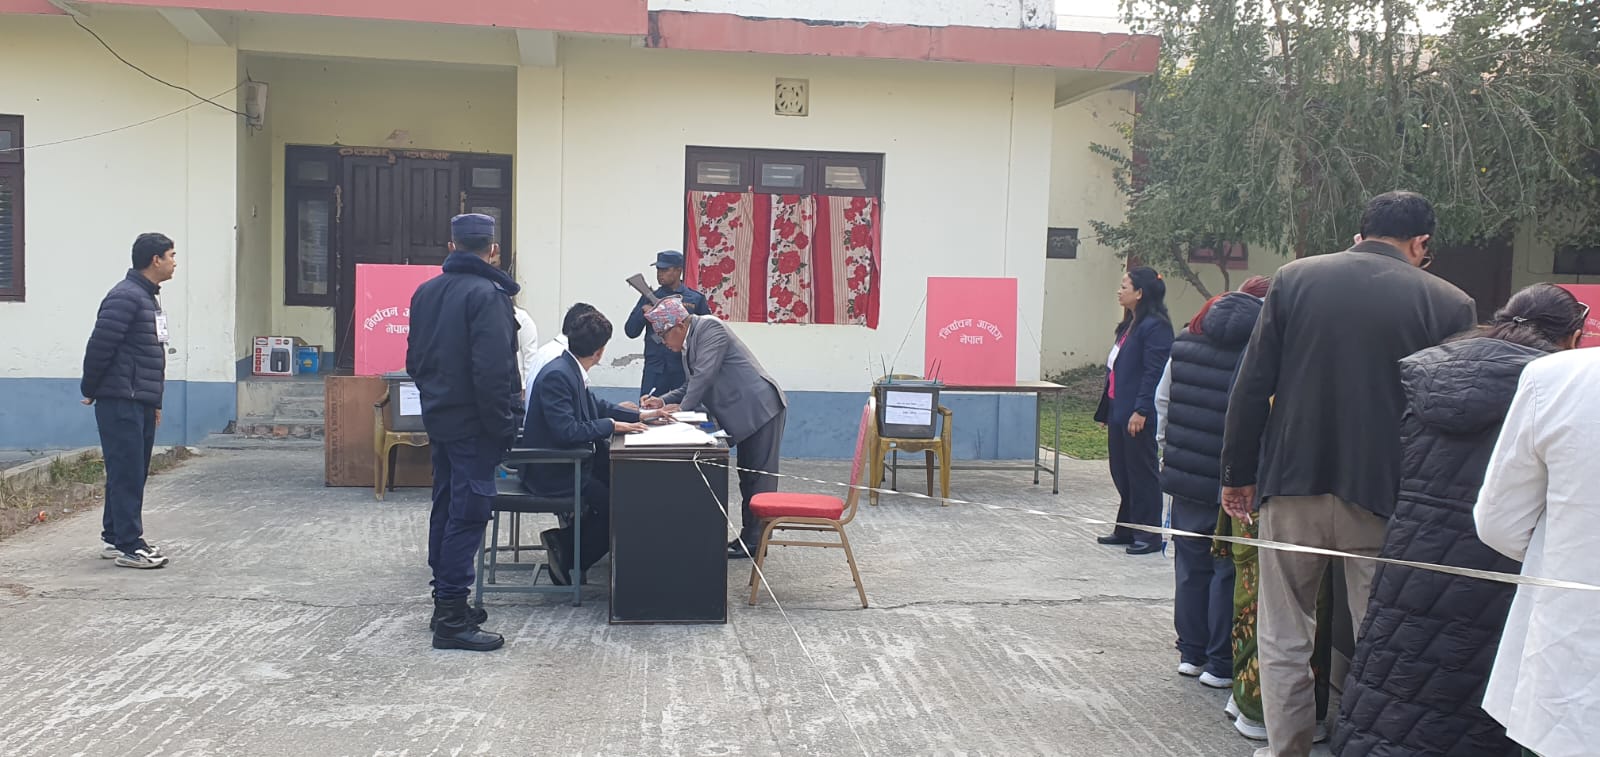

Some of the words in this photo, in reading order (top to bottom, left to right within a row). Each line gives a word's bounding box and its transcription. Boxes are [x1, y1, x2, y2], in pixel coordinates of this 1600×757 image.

[364, 306, 398, 331] निर्वाचन
[385, 323, 410, 334] नेपाल
[939, 319, 972, 339] निर्वाचन
[977, 320, 1002, 340] आयोग
[960, 334, 983, 344] नेपाल
